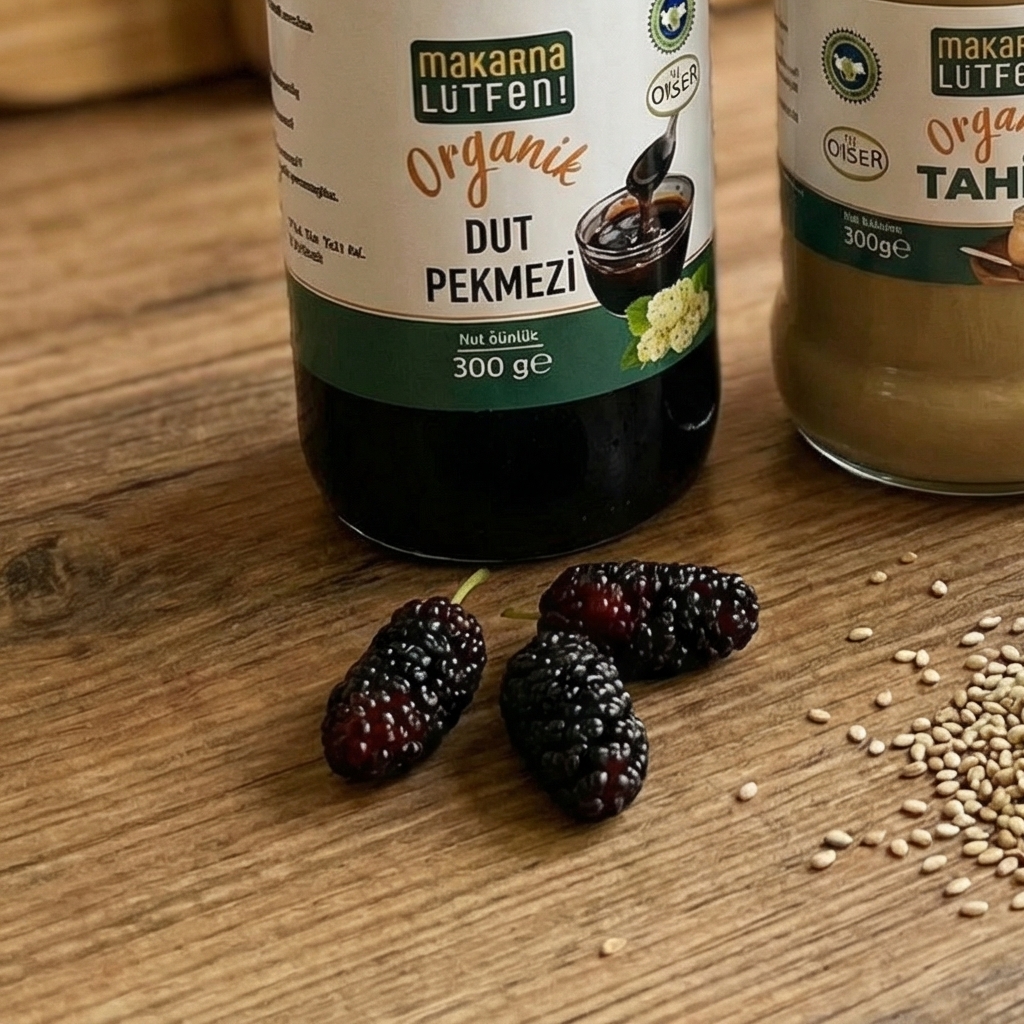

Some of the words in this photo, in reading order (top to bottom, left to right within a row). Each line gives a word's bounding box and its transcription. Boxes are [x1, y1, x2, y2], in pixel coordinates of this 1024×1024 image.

[406, 130, 588, 209] Organik
[465, 215, 533, 255] DUT
[425, 250, 576, 304] PEKMEZİ
[453, 356, 505, 378] 300
